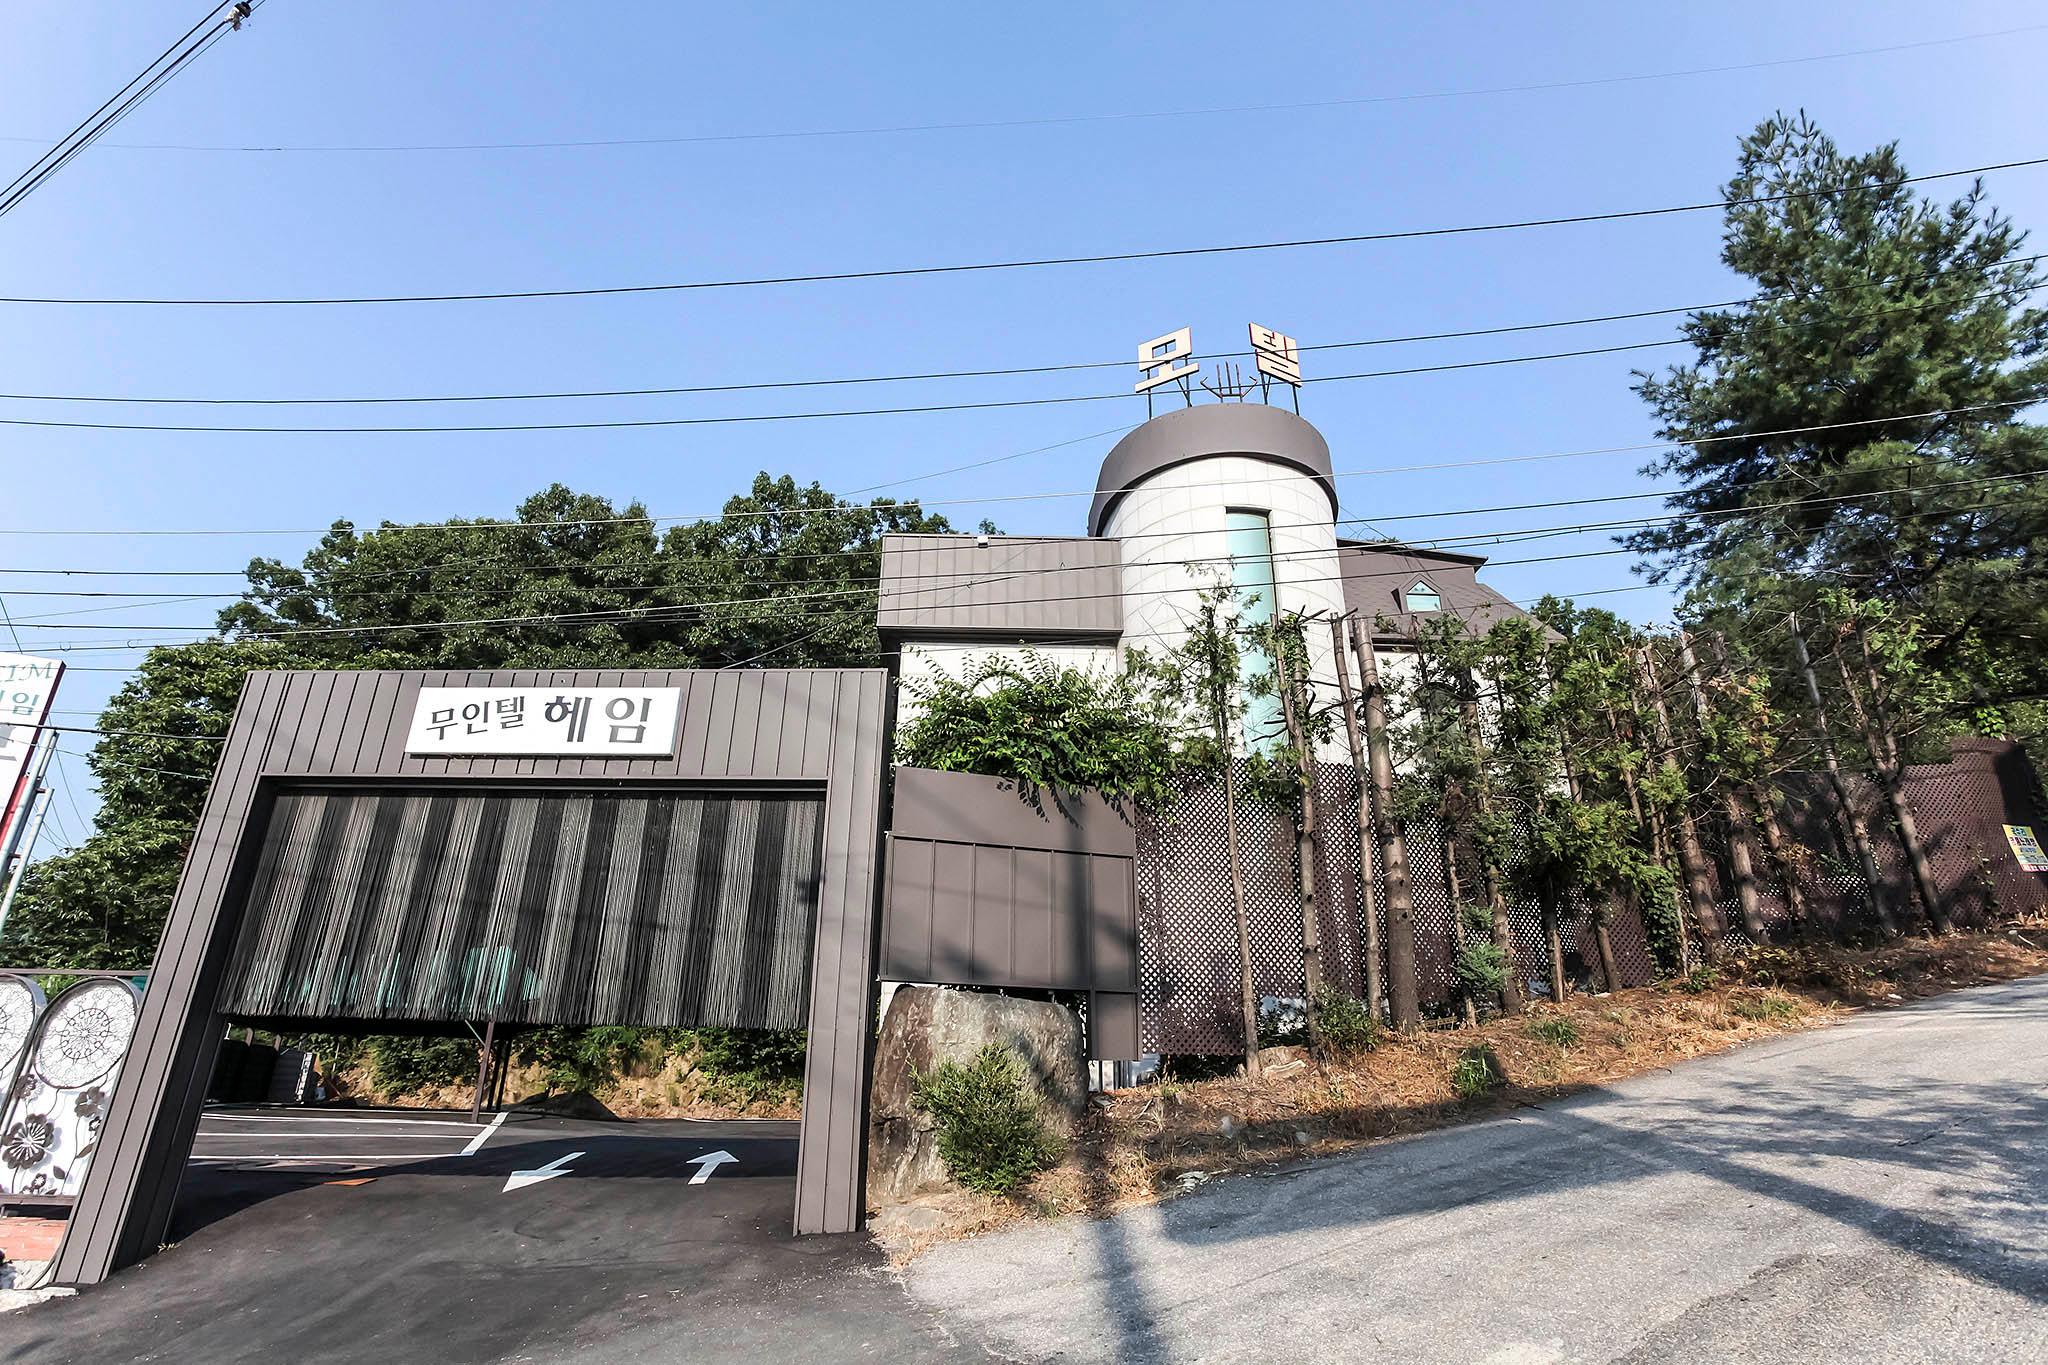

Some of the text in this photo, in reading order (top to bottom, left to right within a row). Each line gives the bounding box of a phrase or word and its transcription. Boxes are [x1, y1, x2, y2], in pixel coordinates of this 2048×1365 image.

[0, 661, 53, 682] IM
[0, 690, 40, 716] 임
[426, 695, 653, 743] 무인텔 헤임
